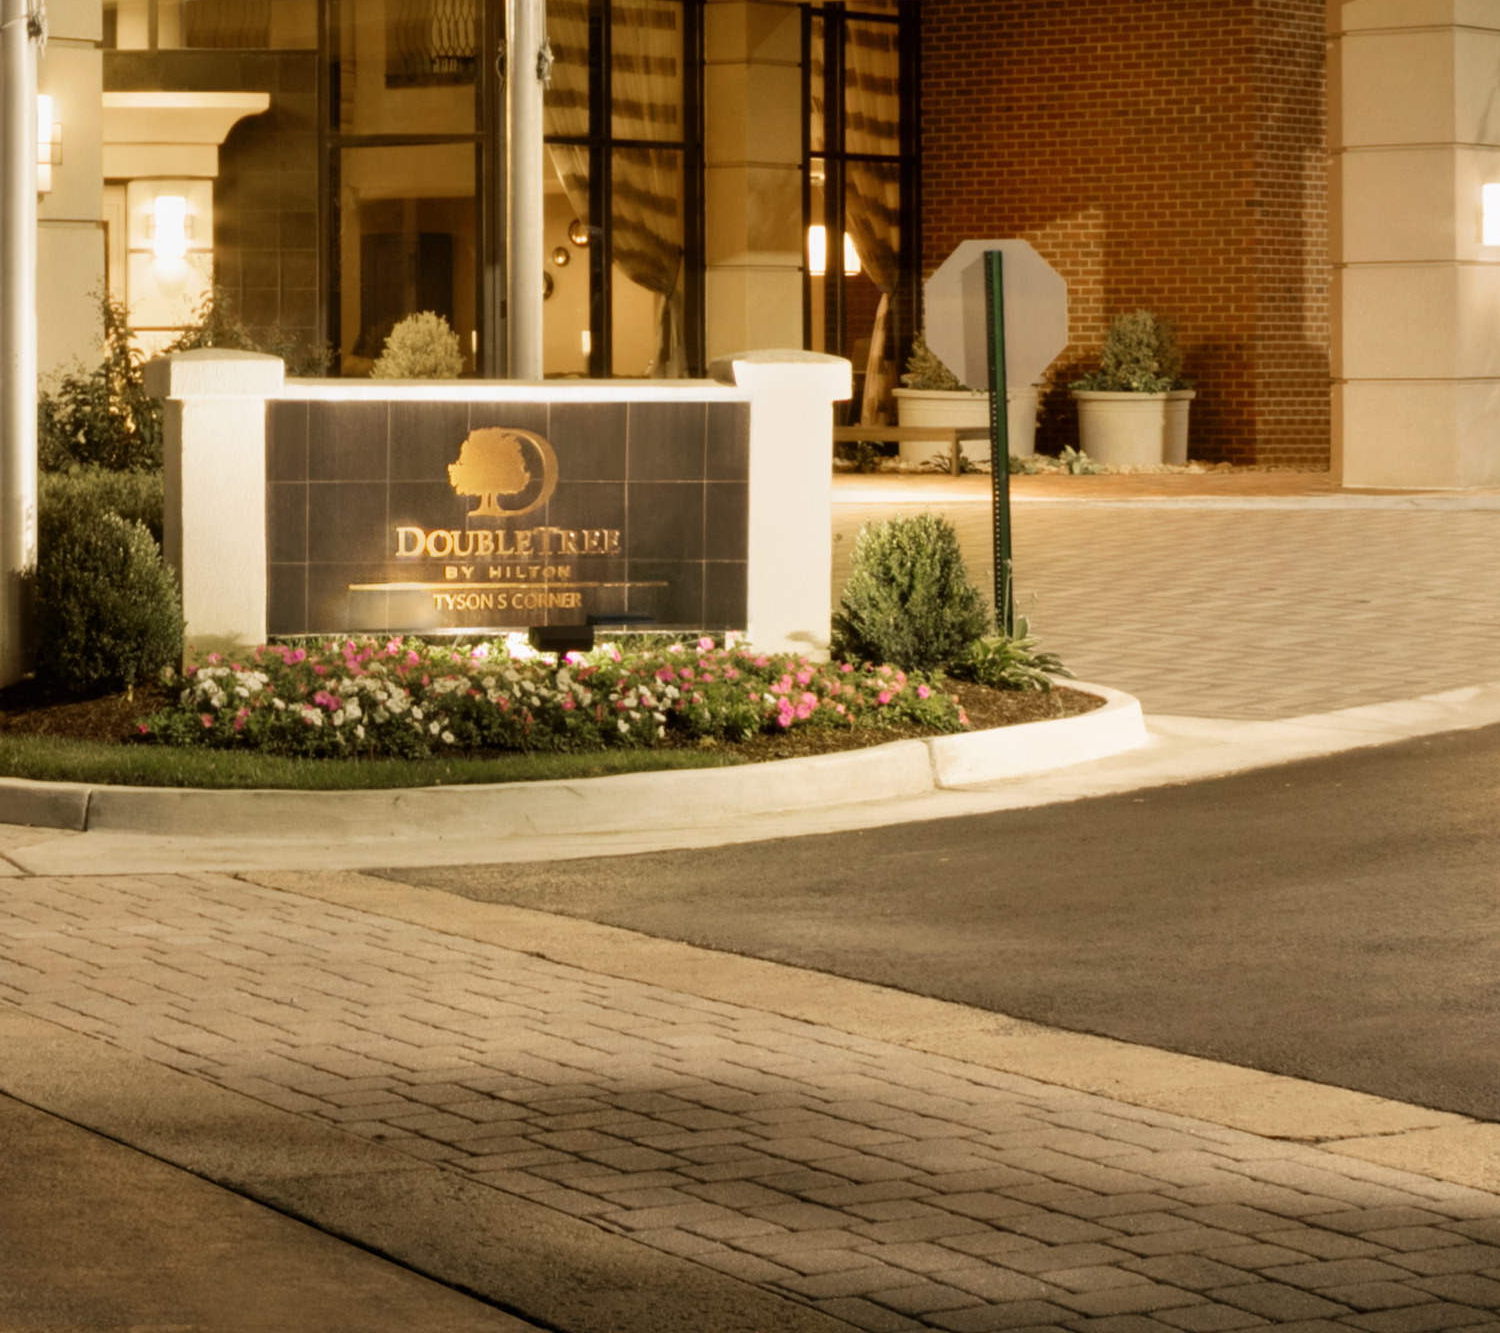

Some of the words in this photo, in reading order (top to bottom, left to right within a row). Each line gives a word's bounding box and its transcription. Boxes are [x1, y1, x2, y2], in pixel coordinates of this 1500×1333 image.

[395, 526, 622, 557] DOUBLETREE
[444, 565, 475, 579] BY
[489, 565, 571, 579] HILTON
[512, 592, 582, 609] CORNER
